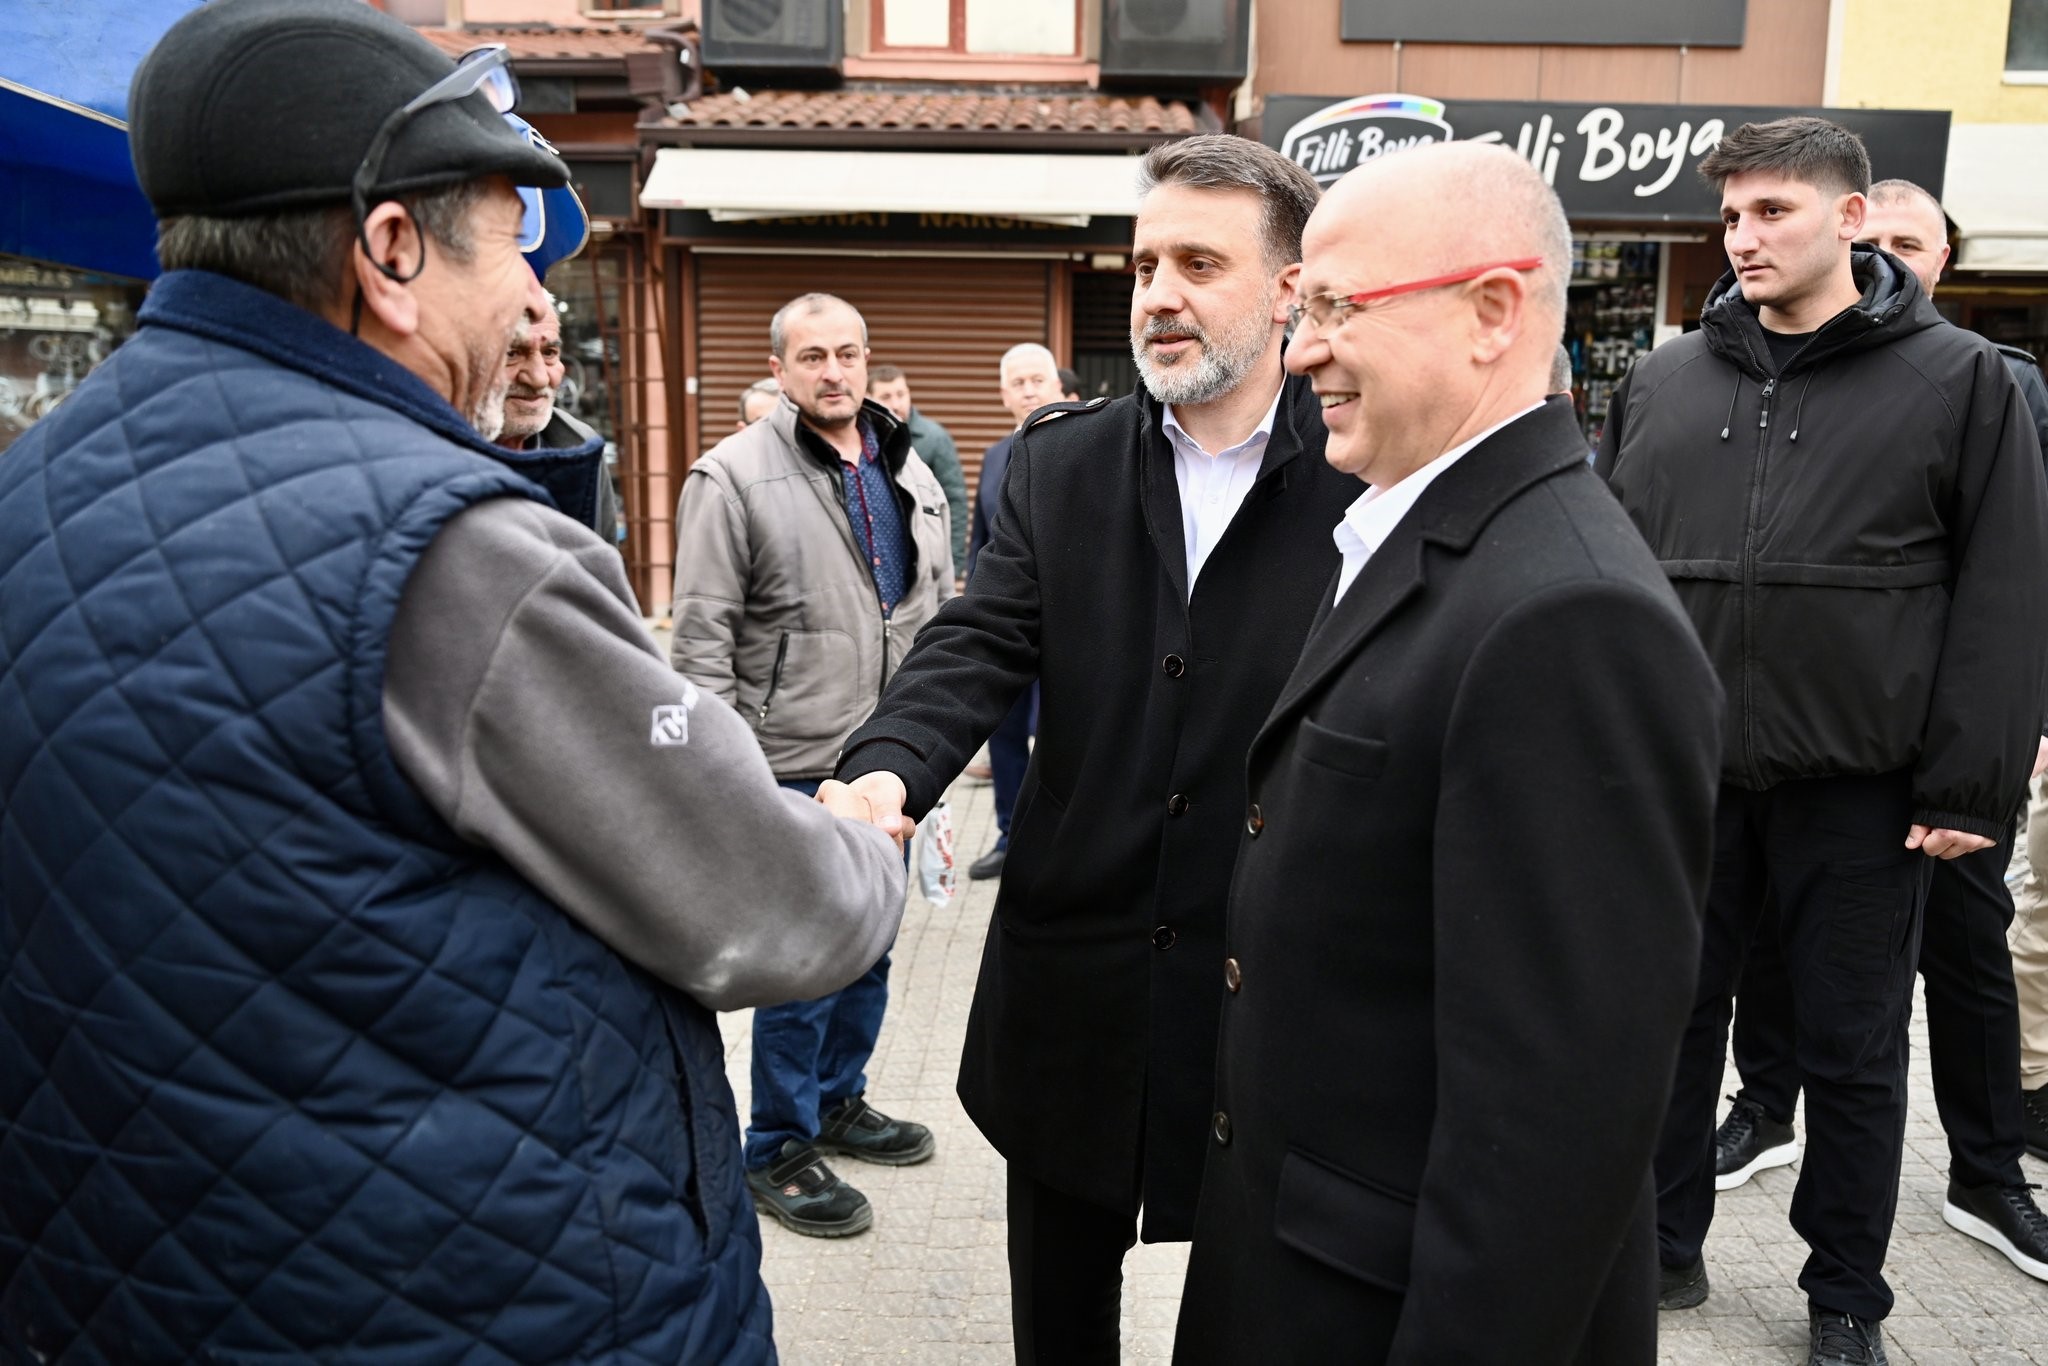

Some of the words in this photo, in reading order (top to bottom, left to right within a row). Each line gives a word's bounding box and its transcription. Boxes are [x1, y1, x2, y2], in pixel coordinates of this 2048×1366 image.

[1296, 127, 1355, 174] Filli
[1466, 113, 1566, 188] lli
[1576, 107, 1725, 197] Boya
